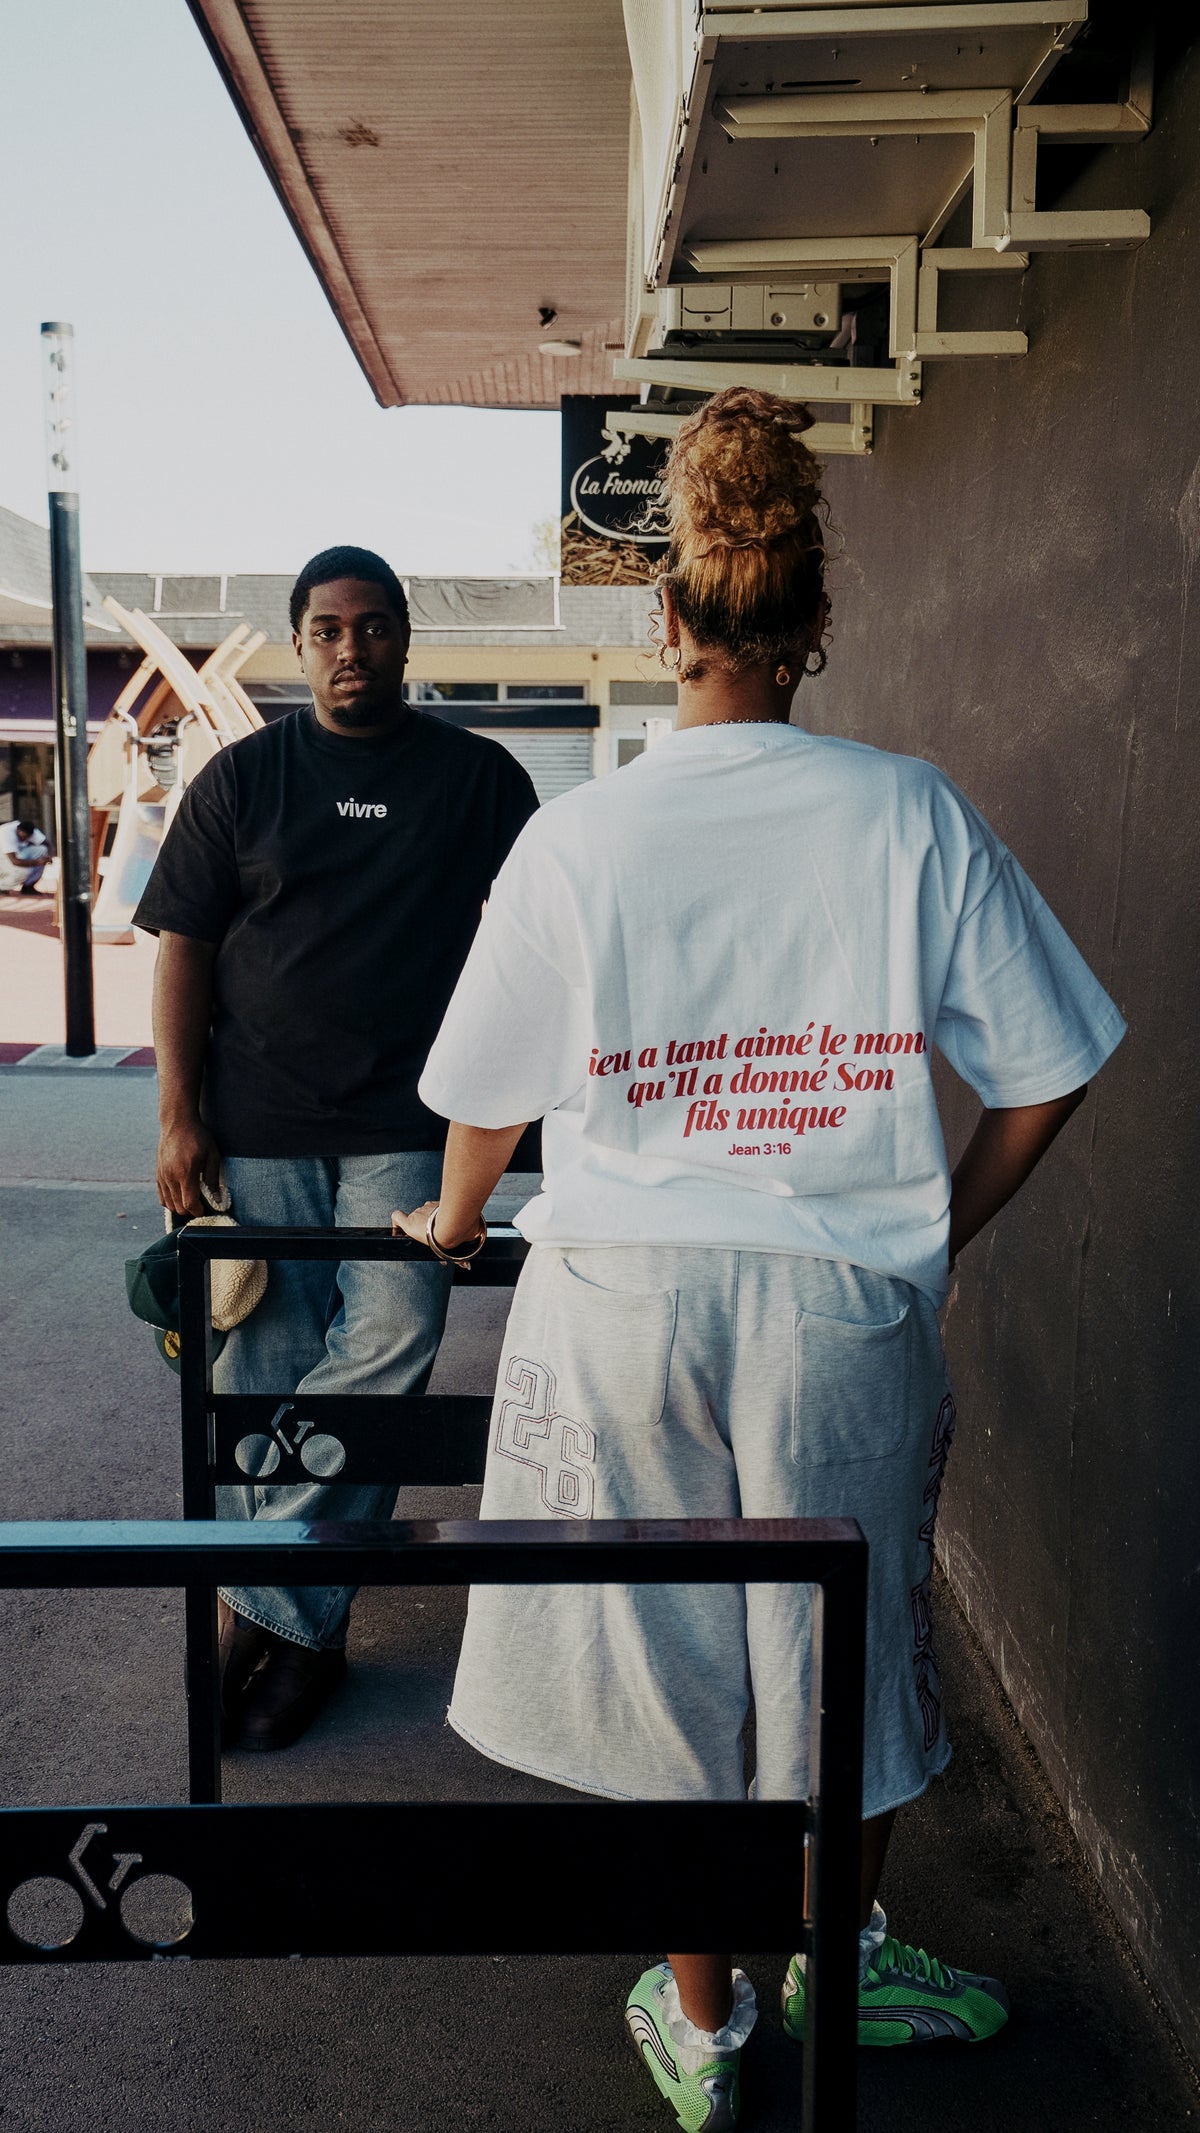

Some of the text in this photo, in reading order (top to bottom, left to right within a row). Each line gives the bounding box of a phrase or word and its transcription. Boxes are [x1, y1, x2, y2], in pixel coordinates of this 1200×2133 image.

[579, 472, 669, 497] La Froma
[336, 797, 387, 818] vivre
[588, 1021, 927, 1077] ieu a tant aimé le mon
[702, 1073, 723, 1095] a
[729, 1058, 828, 1095] donné
[833, 1062, 895, 1092] Son
[682, 1097, 848, 1138] fils unique
[728, 1143, 792, 1156] Jean 3:16
